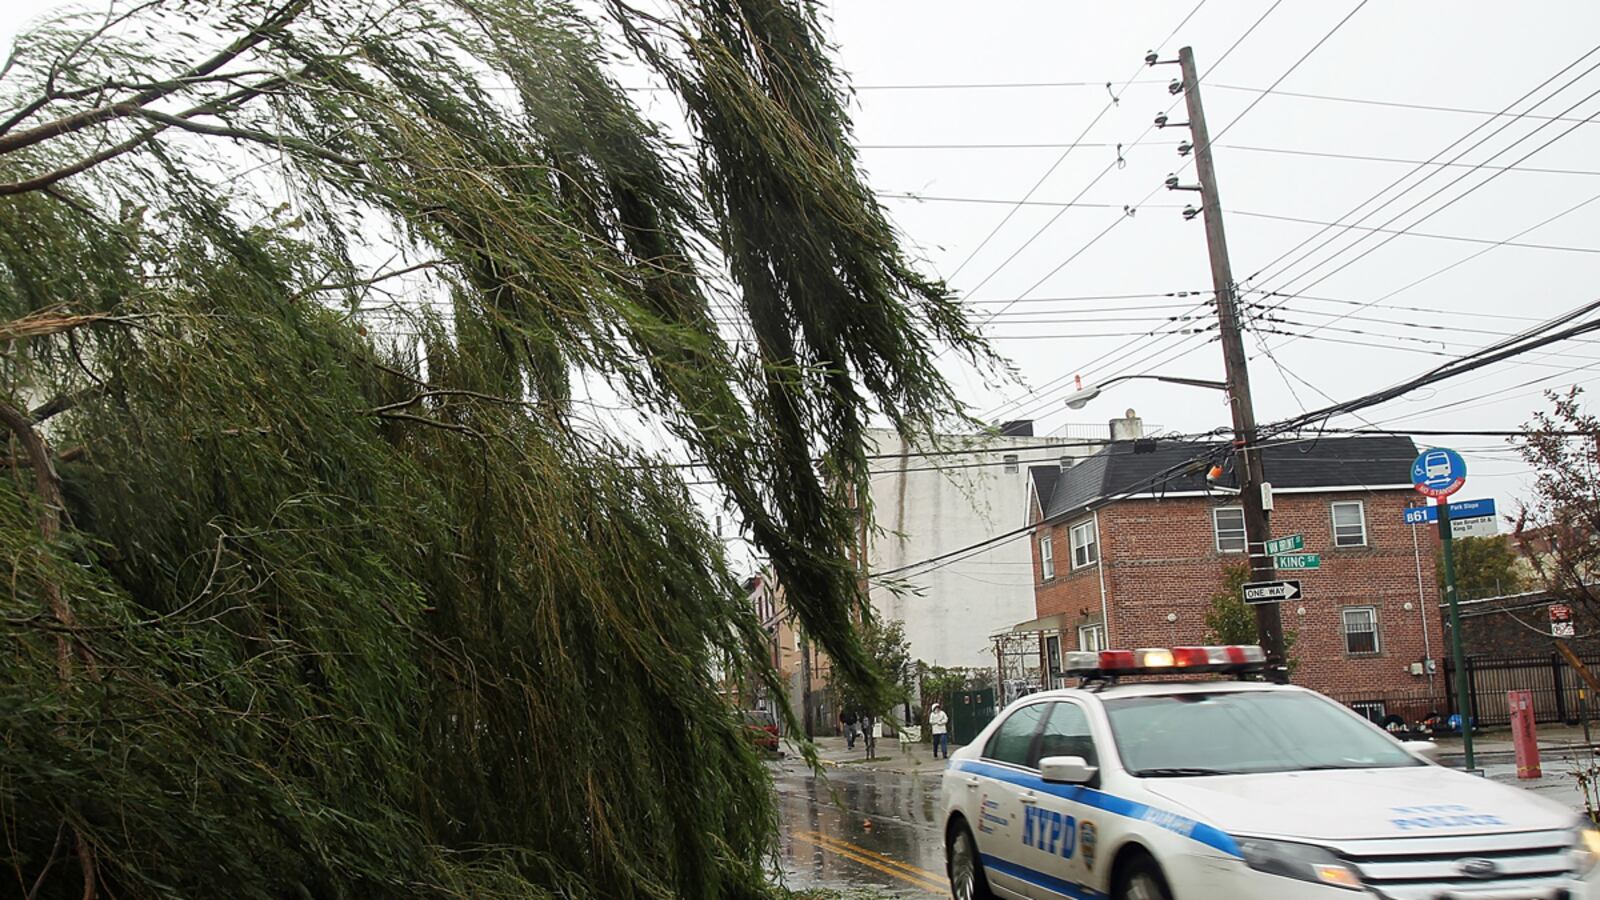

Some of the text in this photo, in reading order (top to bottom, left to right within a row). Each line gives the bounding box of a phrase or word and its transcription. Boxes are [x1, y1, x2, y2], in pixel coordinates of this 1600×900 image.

[1419, 485, 1429, 494] NO
[1406, 510, 1428, 522] B61
[1280, 556, 1306, 568] KING
[1247, 586, 1285, 598] ONE WAY
[1023, 804, 1077, 860] NYPD
